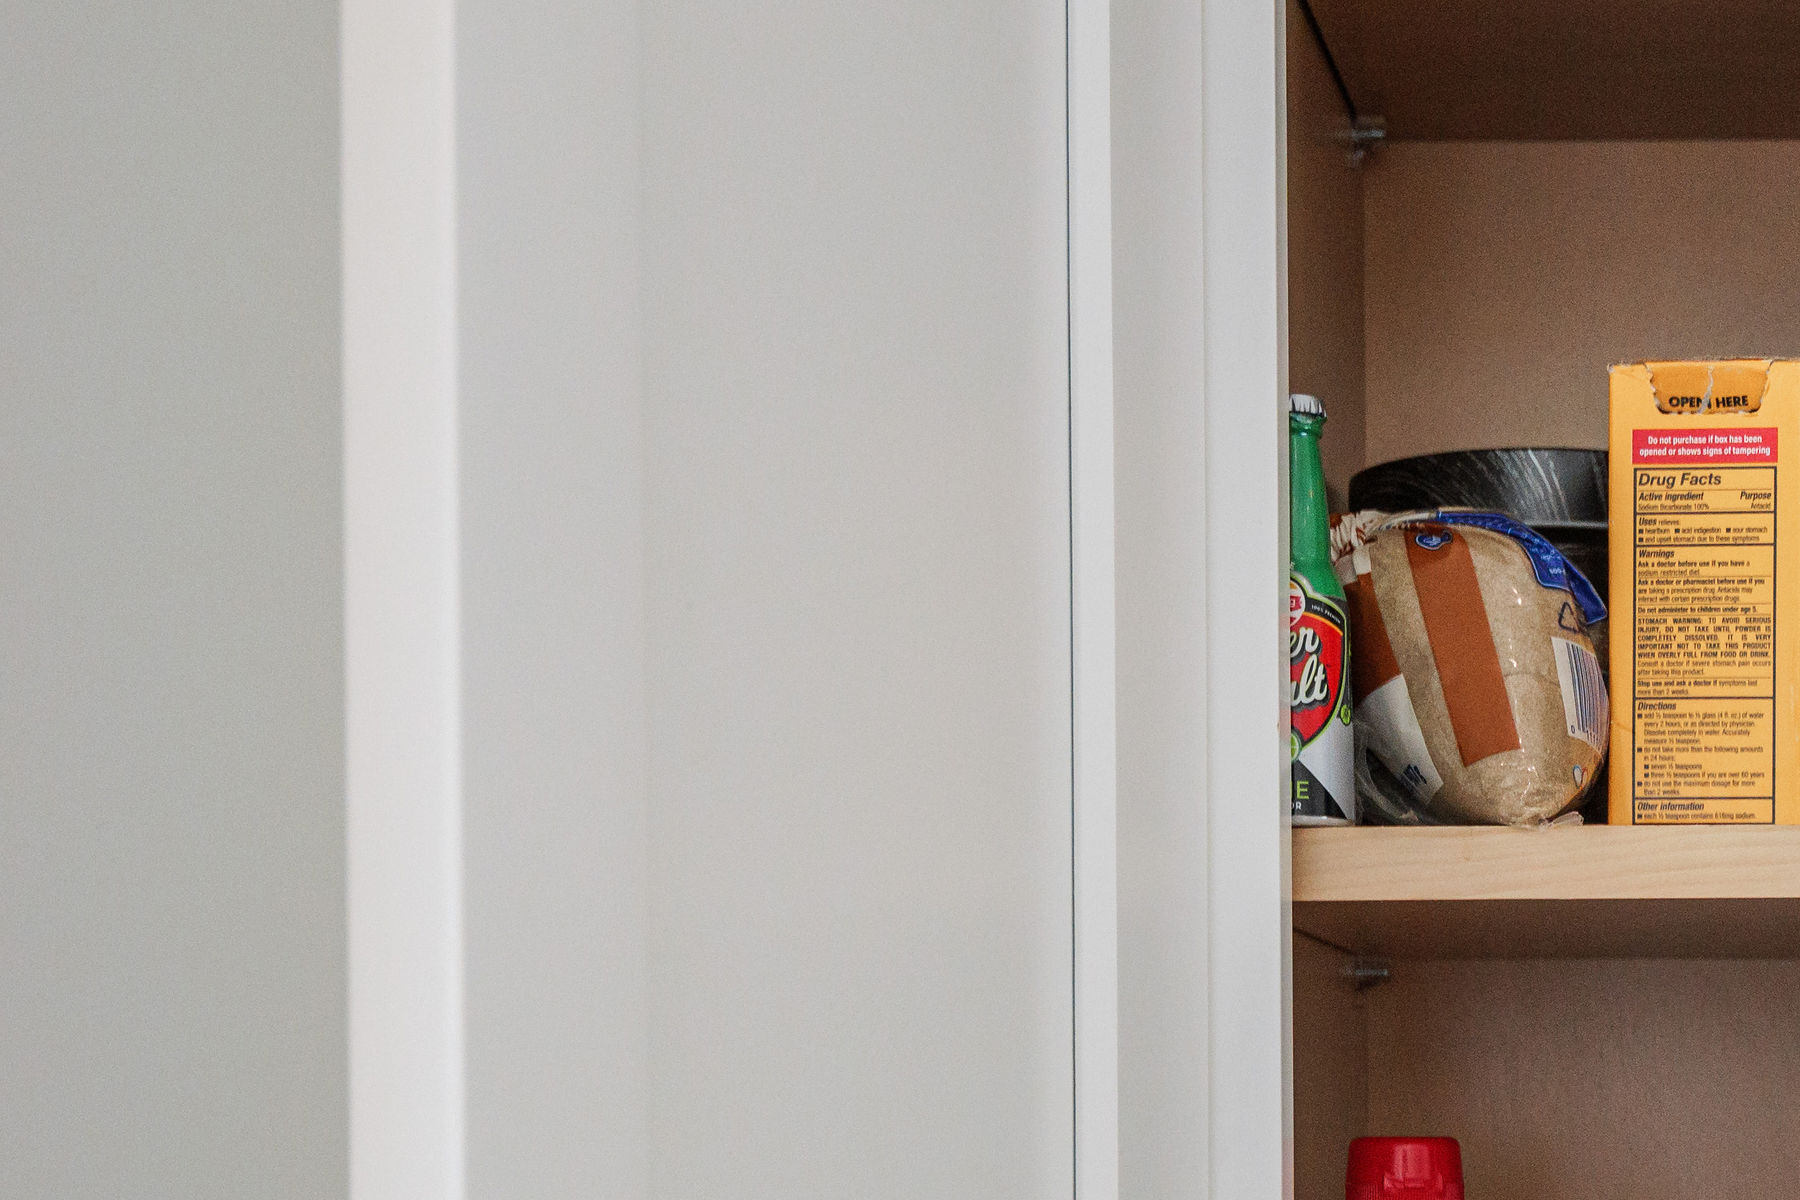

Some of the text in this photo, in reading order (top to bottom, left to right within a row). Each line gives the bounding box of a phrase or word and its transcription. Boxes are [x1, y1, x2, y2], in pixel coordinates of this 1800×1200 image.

[1669, 395, 1748, 408] OPEN HERE
[1648, 436, 1658, 444] Do
[1660, 436, 1671, 444] not
[1673, 436, 1706, 445] purchase
[1715, 435, 1727, 444] box
[1729, 435, 1742, 444] has
[1744, 435, 1762, 443] been
[1640, 447, 1666, 456] opened
[1678, 447, 1701, 455] shows
[1703, 447, 1722, 456] signs
[1733, 446, 1770, 456] tampering
[1639, 473, 1721, 489] Drug Facts
[1639, 492, 1703, 502] Active ingredient
[1740, 491, 1771, 501] Purpose
[1639, 517, 1656, 526] Uses
[1640, 550, 1674, 559] Warnings
[1638, 702, 1676, 711] Directions
[1638, 802, 1704, 810] Other information
